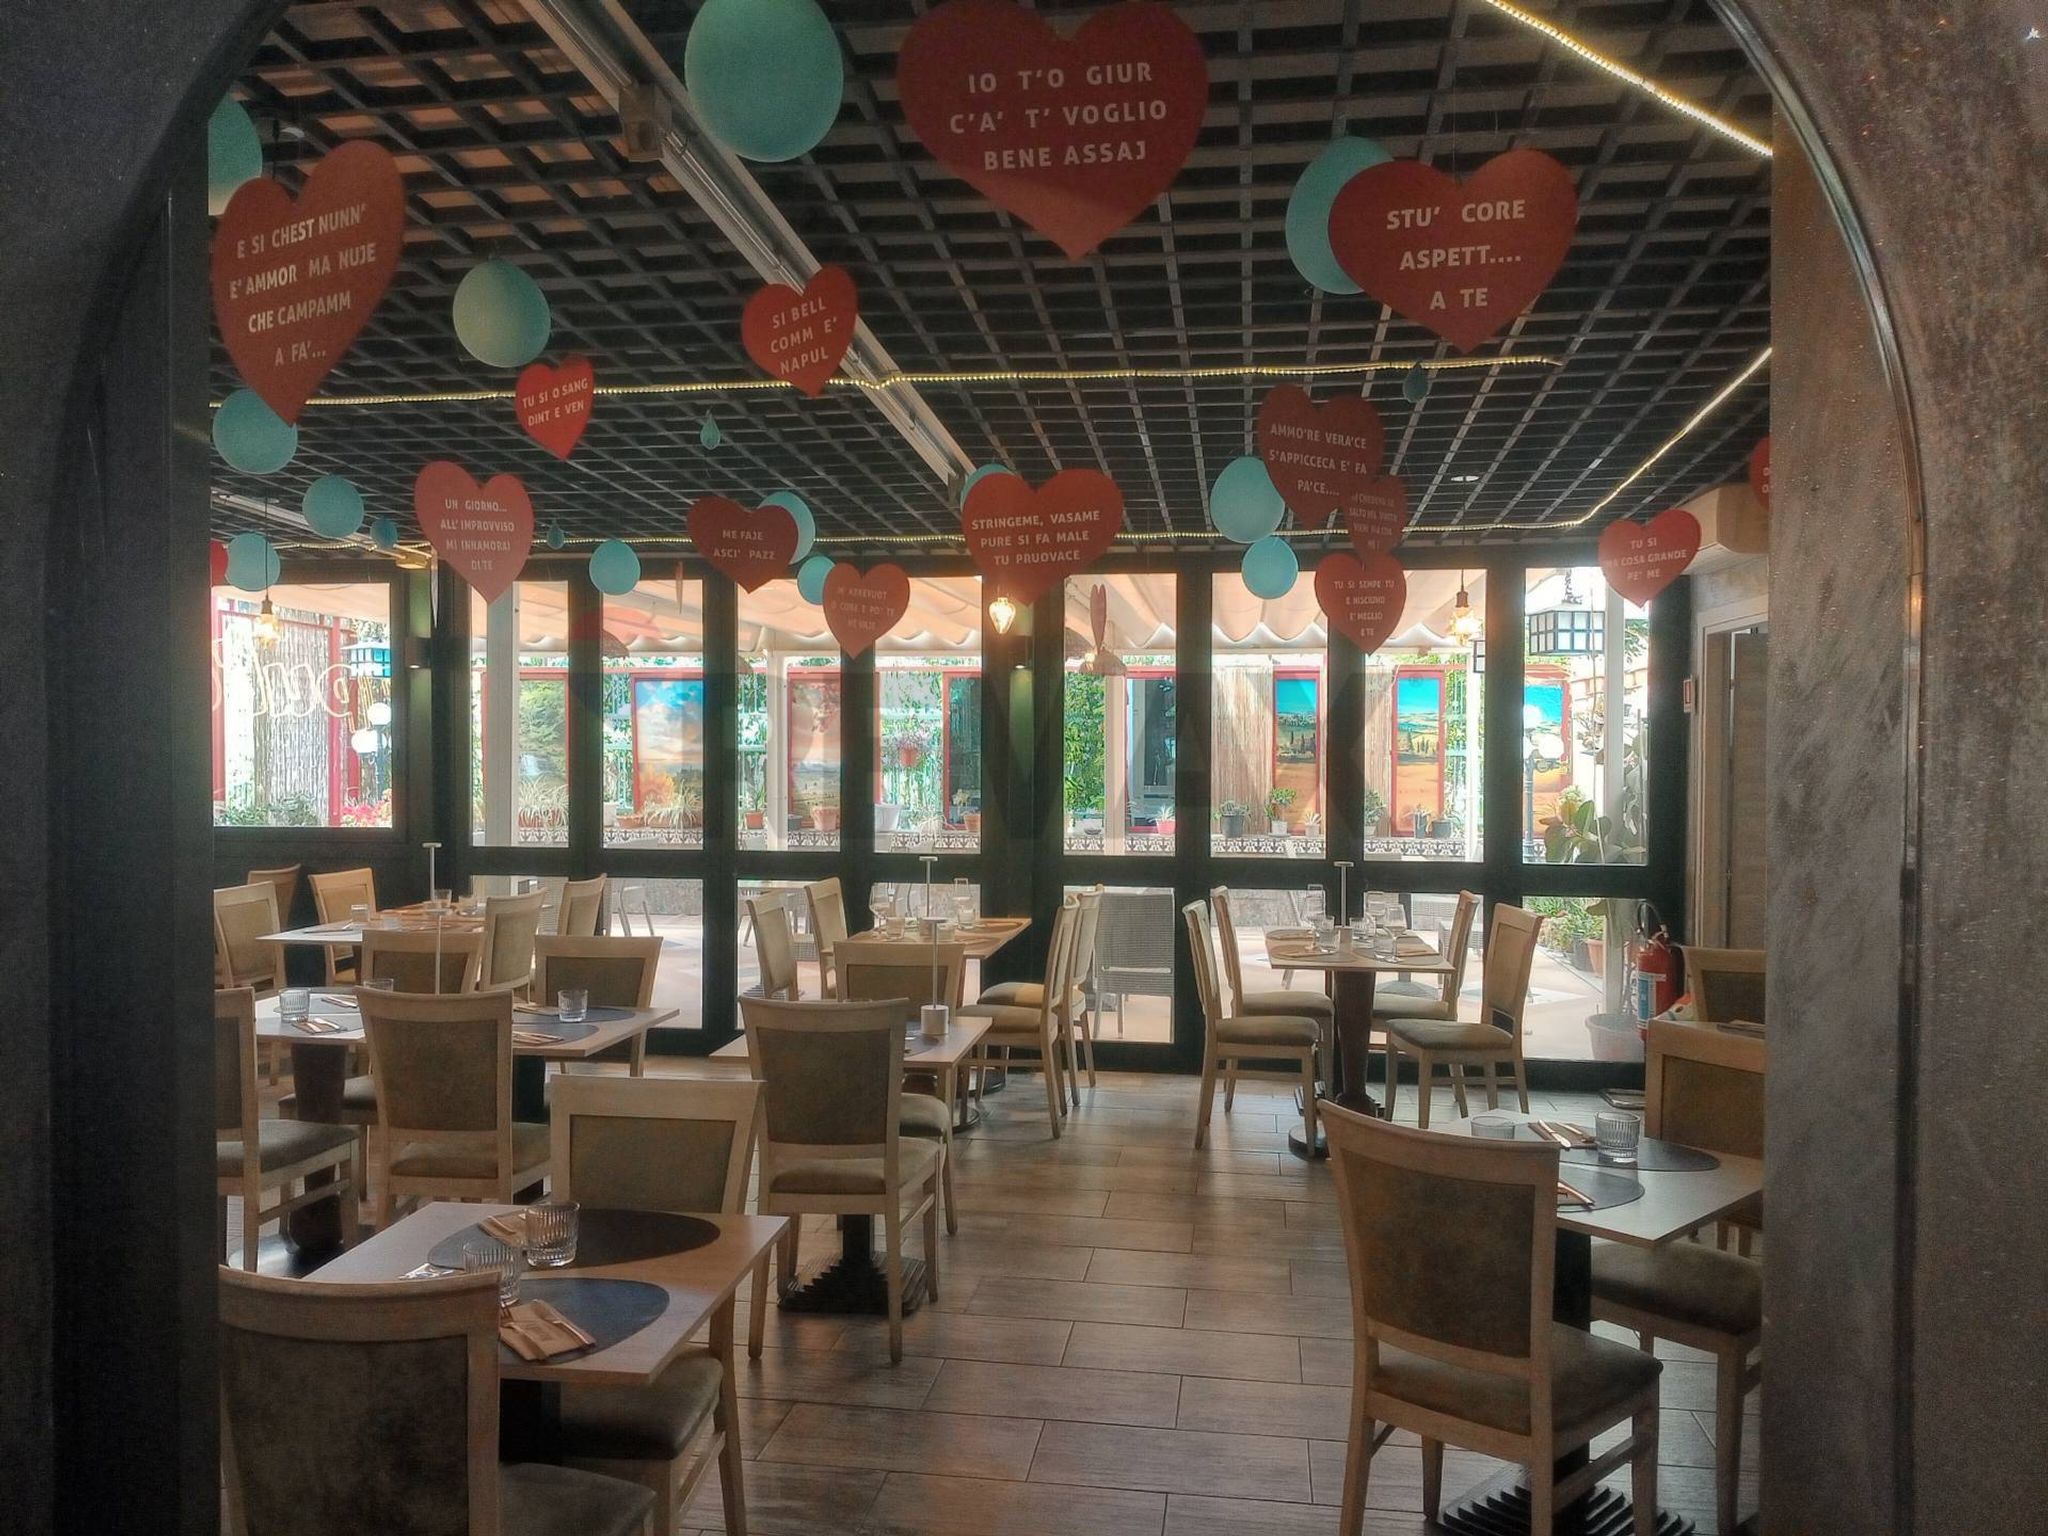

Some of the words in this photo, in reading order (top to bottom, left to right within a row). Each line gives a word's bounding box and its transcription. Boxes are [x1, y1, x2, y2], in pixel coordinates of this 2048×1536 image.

[968, 73, 997, 94] IO
[1086, 62, 1153, 86] GIUR
[1025, 108, 1051, 129] T'
[1062, 100, 1167, 126] VOGLIO
[984, 148, 1052, 171] BENE
[1063, 140, 1147, 166] ASSAJ
[1386, 206, 1441, 230] STU'
[1461, 199, 1526, 223] CORE
[237, 239, 245, 259] E
[251, 233, 265, 255] SI
[271, 219, 315, 248] CHEST
[318, 203, 367, 235] NUNN'
[230, 280, 242, 299] E'
[246, 264, 297, 295] AMMOR
[309, 255, 331, 278] MA
[339, 243, 376, 270] NUJE
[1399, 245, 1522, 271] ASPETT....
[248, 310, 274, 333] CHE
[277, 290, 351, 325] CAMPAMM
[1429, 291, 1447, 310] A
[1460, 288, 1488, 308] TE
[772, 311, 786, 329] SI
[791, 298, 827, 321] BELL
[770, 326, 814, 353] COMM
[824, 316, 837, 333] E'
[275, 347, 284, 367] A
[780, 347, 829, 375] NAPUL
[522, 395, 534, 408] TU
[539, 390, 548, 404] SI
[552, 387, 559, 398] O
[562, 377, 588, 395] SANG
[528, 410, 550, 426] DINT
[554, 407, 560, 418] E
[565, 400, 584, 414] VEN
[1270, 423, 1321, 442] AMMO'RE
[1325, 432, 1367, 449] VERA'CE
[1269, 449, 1336, 470] S'APPICCECA
[1355, 462, 1367, 474] FA
[445, 499, 458, 510] UN
[440, 519, 458, 530] ALL'
[461, 520, 515, 532] IMPROVVISO
[971, 515, 1044, 530] STRINGEME,
[1050, 510, 1100, 525] VASAME
[446, 540, 457, 551] MI
[461, 540, 511, 551] INNAMORAI
[722, 530, 737, 540] ME
[980, 536, 1012, 549] PURE
[1018, 535, 1029, 546] SI
[1036, 533, 1050, 545] FA
[1056, 530, 1090, 543] MALE
[1631, 540, 1643, 550] TU
[1647, 537, 1657, 547] SI
[749, 549, 775, 560] PAZZ
[993, 554, 1009, 566] TU
[1016, 550, 1080, 565] PRUOVACE
[1621, 555, 1645, 566] COSA
[1648, 549, 1687, 562] GRANDE
